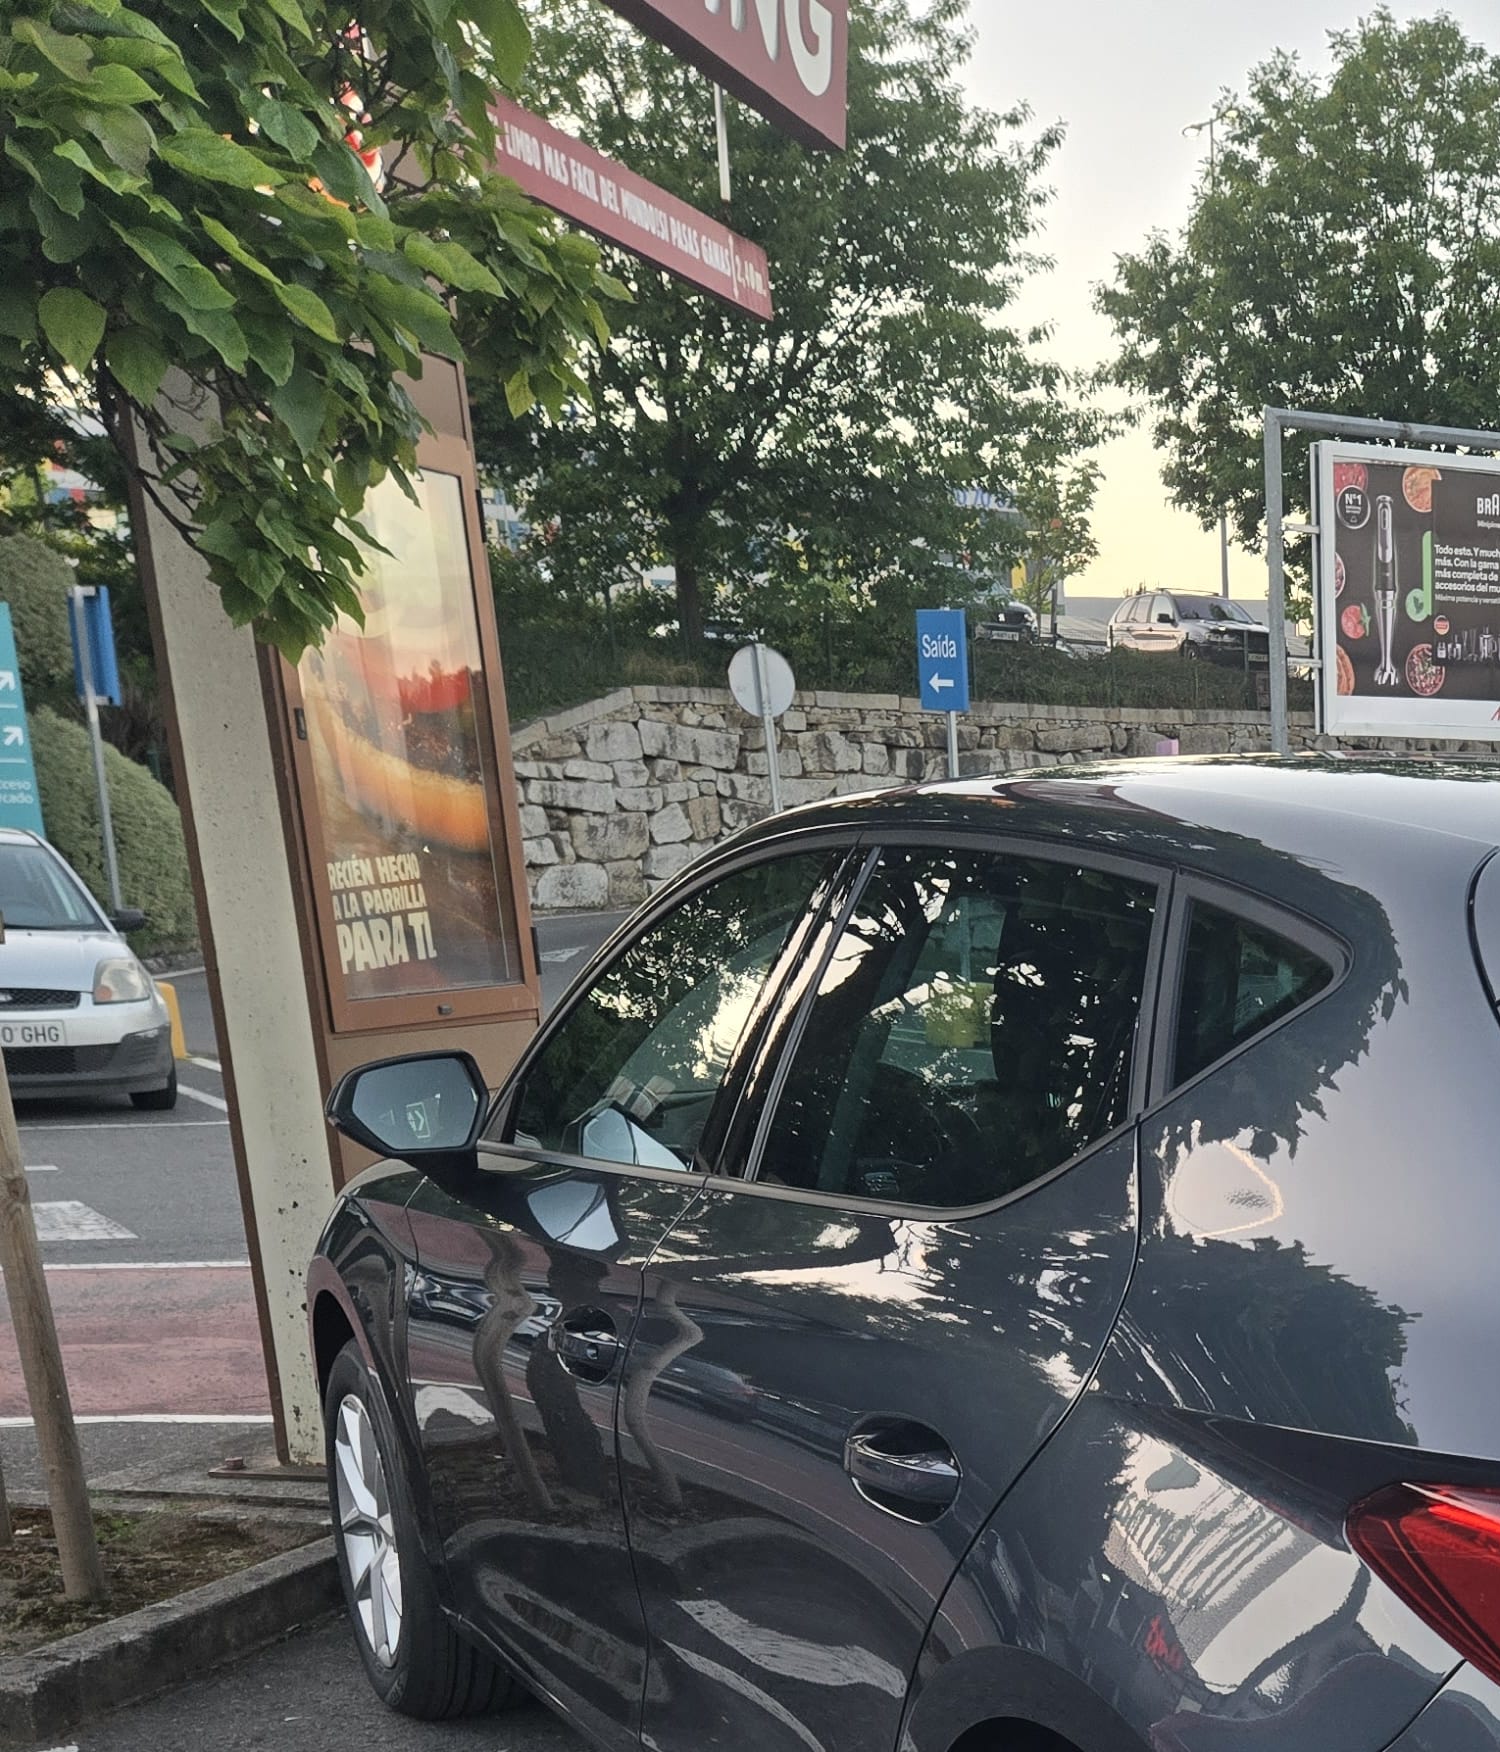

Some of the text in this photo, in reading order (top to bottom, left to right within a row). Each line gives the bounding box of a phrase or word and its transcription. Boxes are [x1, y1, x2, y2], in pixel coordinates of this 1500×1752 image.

[542, 143, 569, 186] MAS
[599, 174, 620, 215] DEL
[669, 216, 700, 260] PASAS
[1434, 544, 1453, 555] Todo
[1473, 547, 1480, 557] Y
[1434, 568, 1499, 582] más completa de
[1454, 558, 1469, 567] Con
[1470, 559, 1477, 568] la
[1478, 561, 1500, 571] gama
[1434, 581, 1475, 592] accesorios
[1476, 583, 1488, 593] del
[921, 634, 957, 658] Saída
[327, 852, 420, 891] RECIÉN HECHO
[332, 883, 427, 920] A LA PARRILLA
[336, 914, 410, 974] PARA
[21, 1025, 59, 1043] GHG
